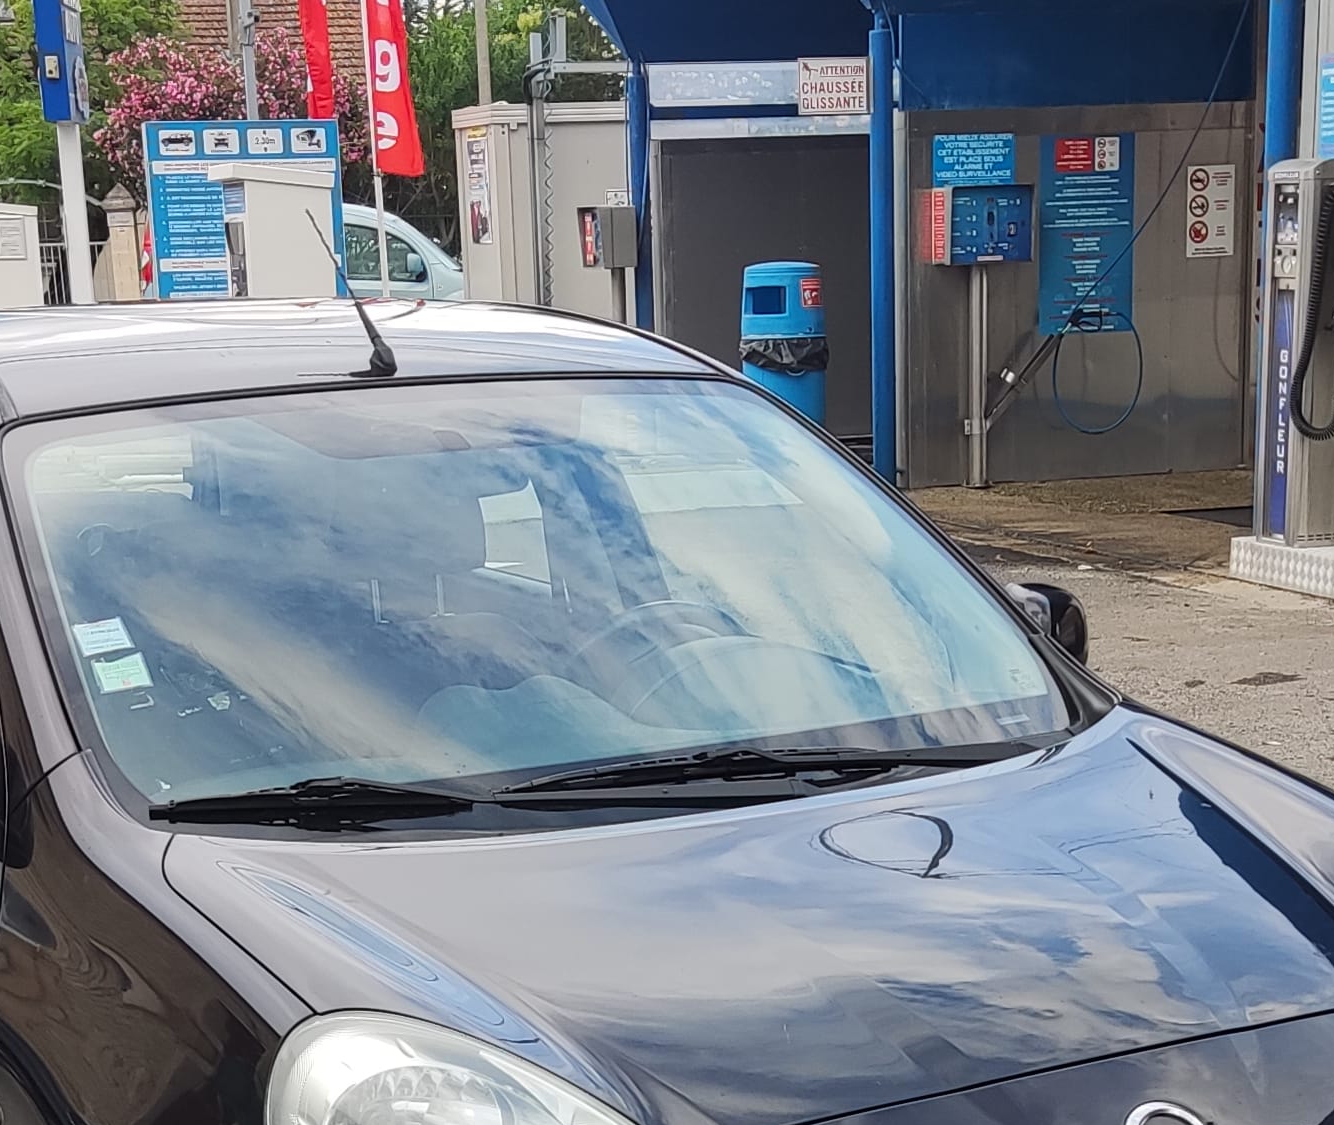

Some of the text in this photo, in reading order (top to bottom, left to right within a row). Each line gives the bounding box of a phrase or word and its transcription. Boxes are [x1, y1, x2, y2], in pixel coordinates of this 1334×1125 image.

[820, 66, 864, 75] ATTENTION
[802, 79, 864, 94] CHAUSSÉE
[803, 96, 864, 109] GLISSANTE
[1276, 349, 1289, 474] GONFLEUR
